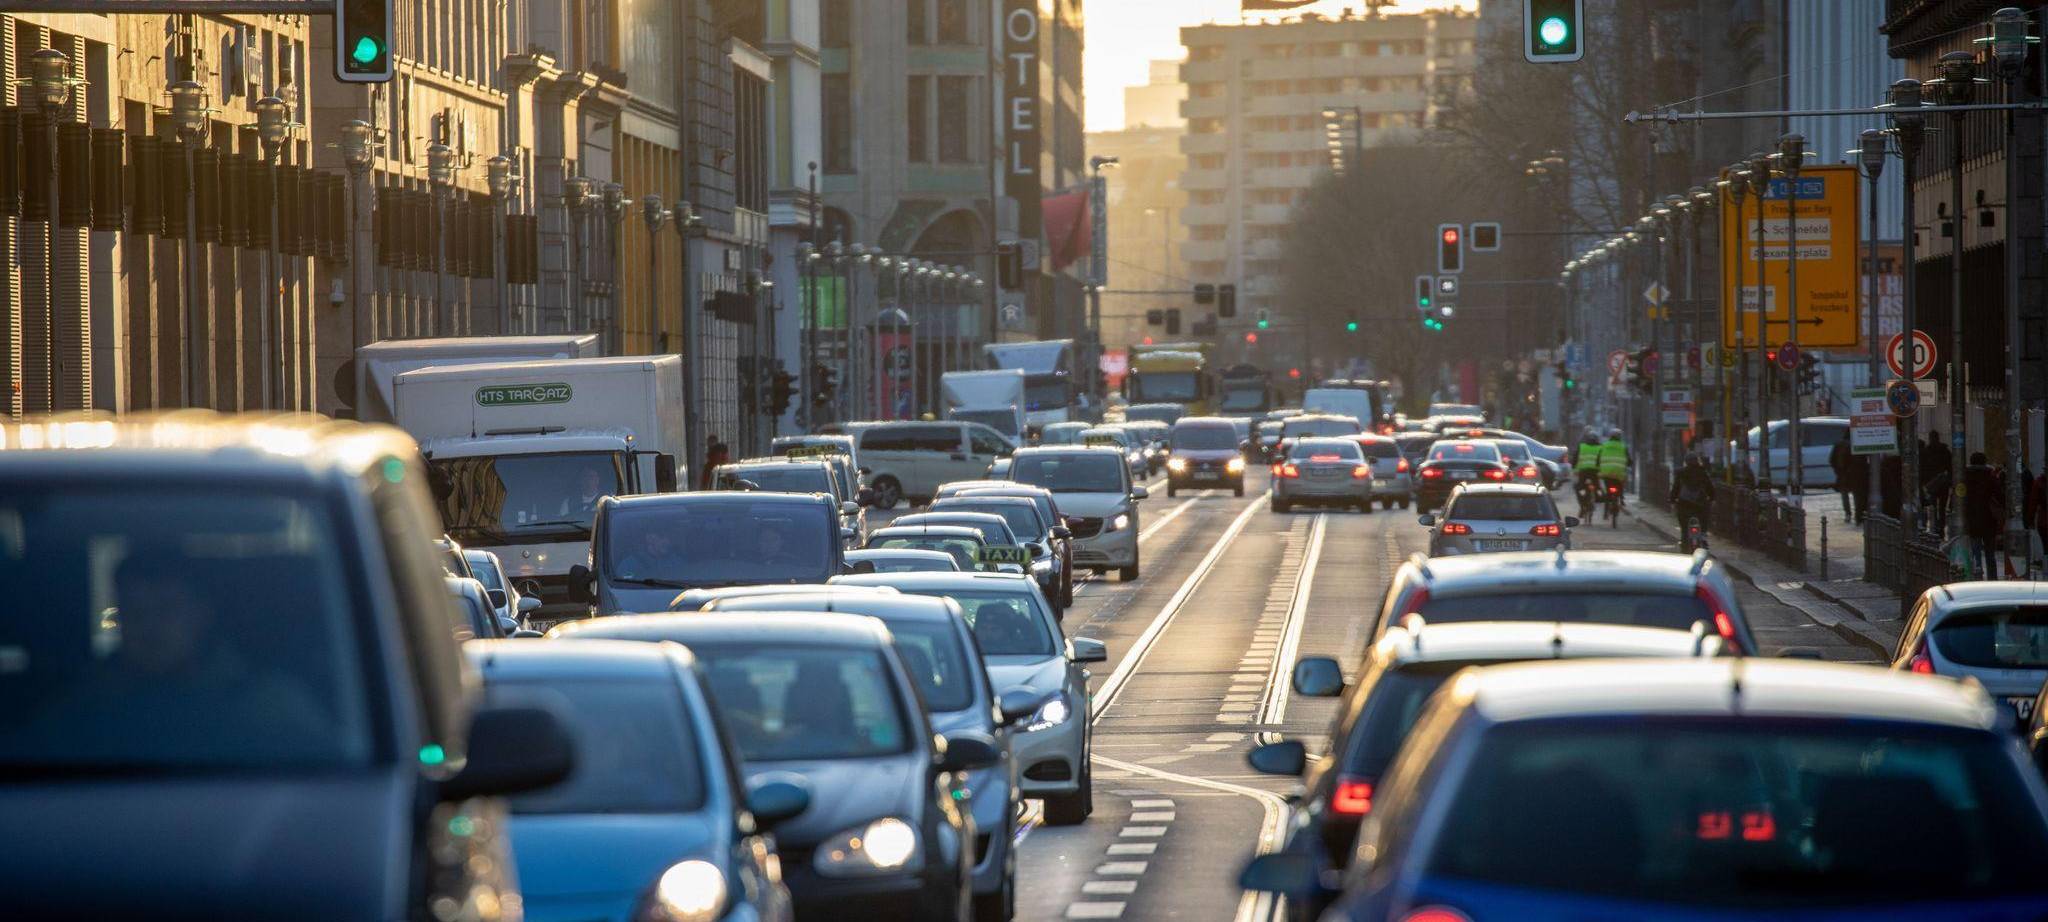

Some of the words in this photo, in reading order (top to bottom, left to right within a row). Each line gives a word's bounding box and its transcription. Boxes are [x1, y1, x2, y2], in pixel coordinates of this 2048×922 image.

[1772, 224, 1829, 235] Schnefeld
[479, 390, 505, 402] HTS
[507, 386, 569, 402] TARGATZ
[984, 548, 1021, 562] TAXI
